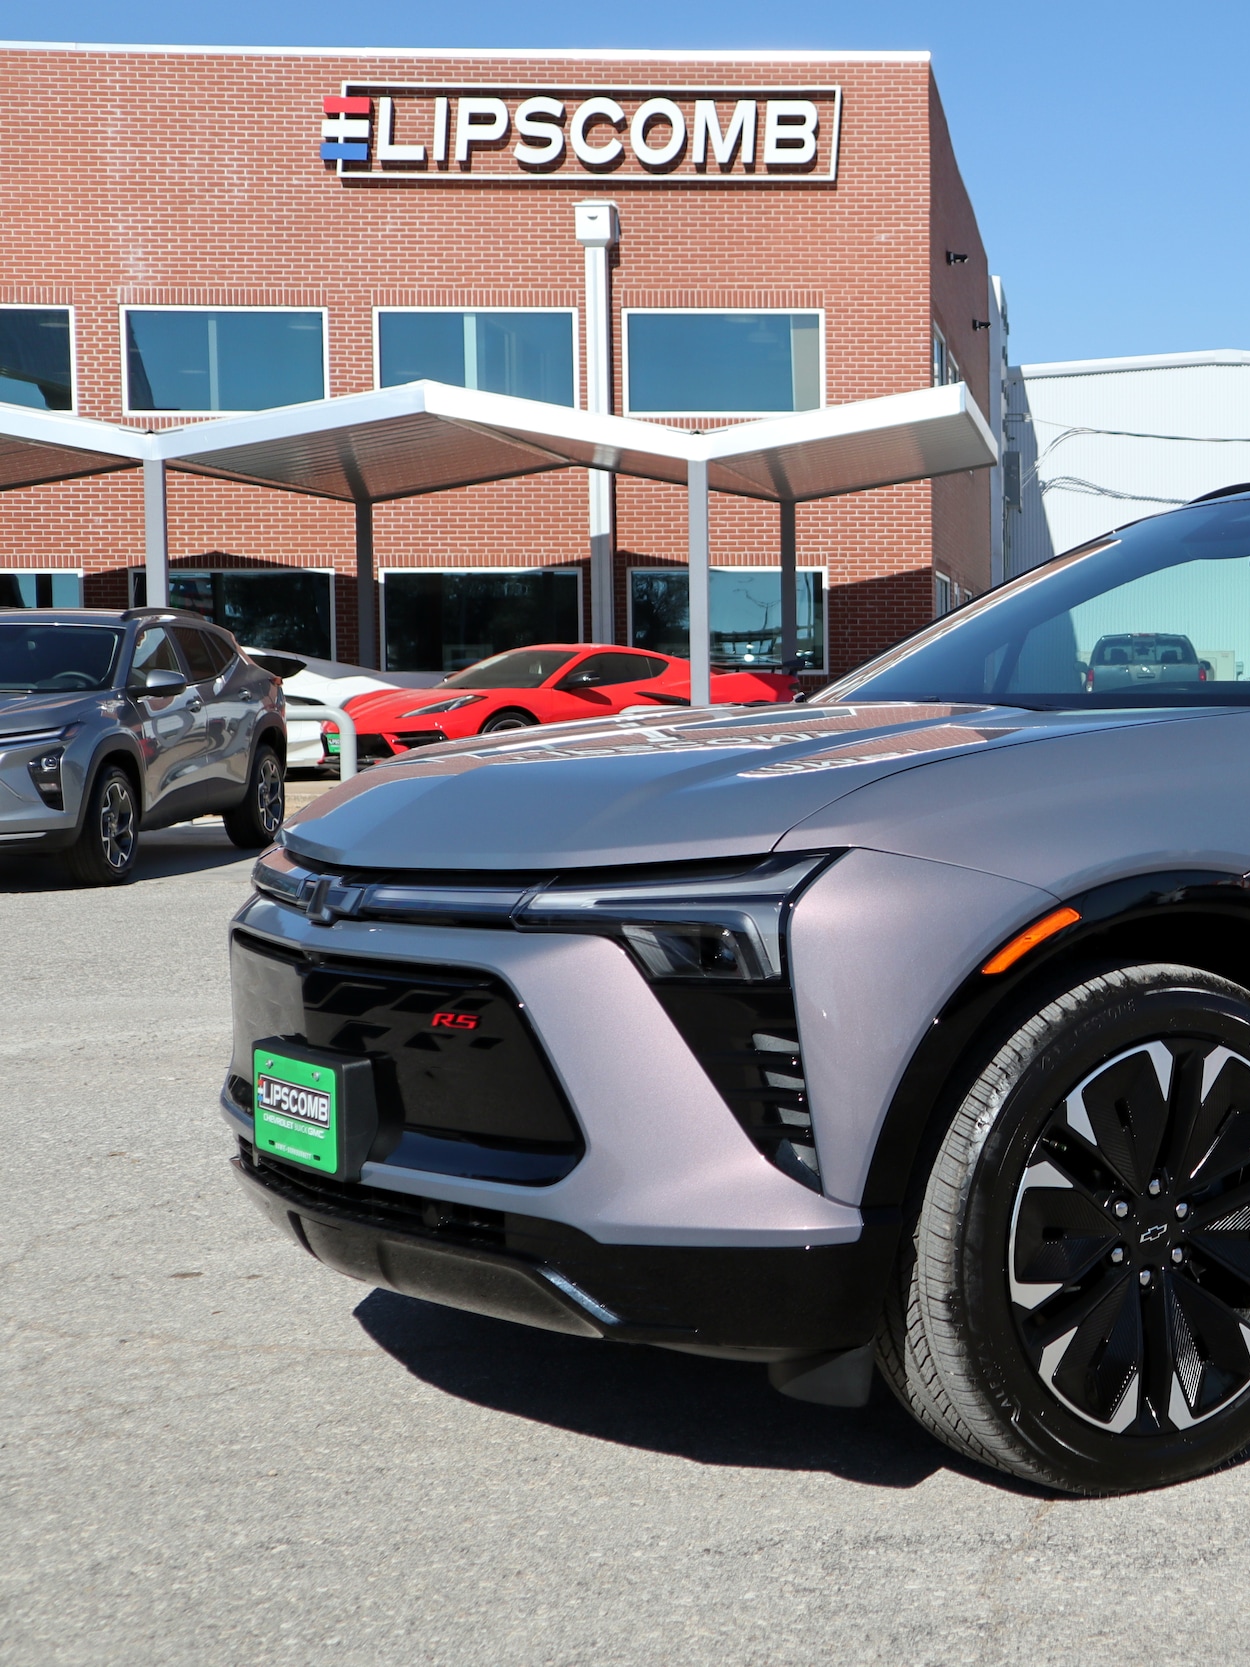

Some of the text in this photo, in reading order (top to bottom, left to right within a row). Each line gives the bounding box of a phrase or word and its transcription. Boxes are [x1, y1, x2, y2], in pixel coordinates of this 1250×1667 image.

[376, 96, 818, 165] LIPSCOMB
[431, 1012, 479, 1030] RS
[262, 1081, 328, 1121] LIPSCOMB
